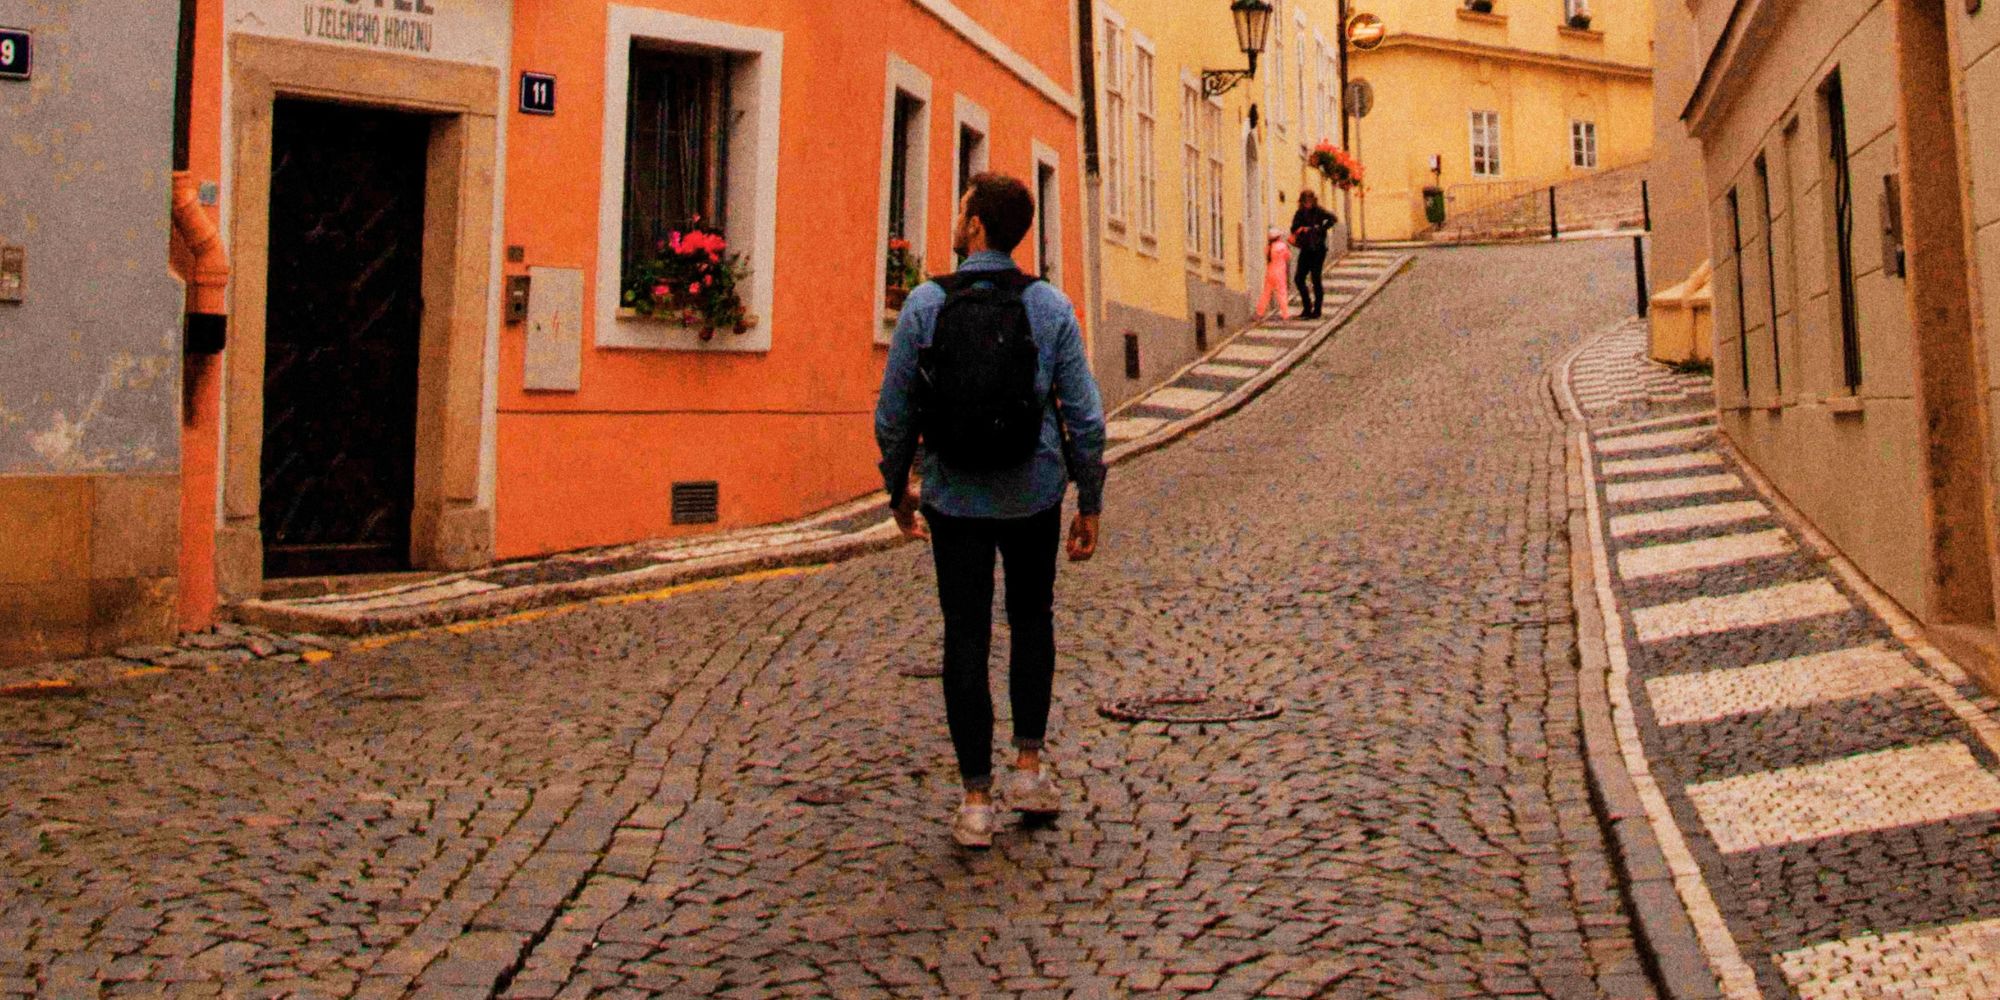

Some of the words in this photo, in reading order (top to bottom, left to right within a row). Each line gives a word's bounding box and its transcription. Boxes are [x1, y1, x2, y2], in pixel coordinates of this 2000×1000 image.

[303, 4, 314, 36] U
[318, 5, 380, 45] ZELENÉHO
[384, 16, 433, 52] HROZNU
[1, 39, 15, 65] 9
[533, 82, 546, 105] 11
